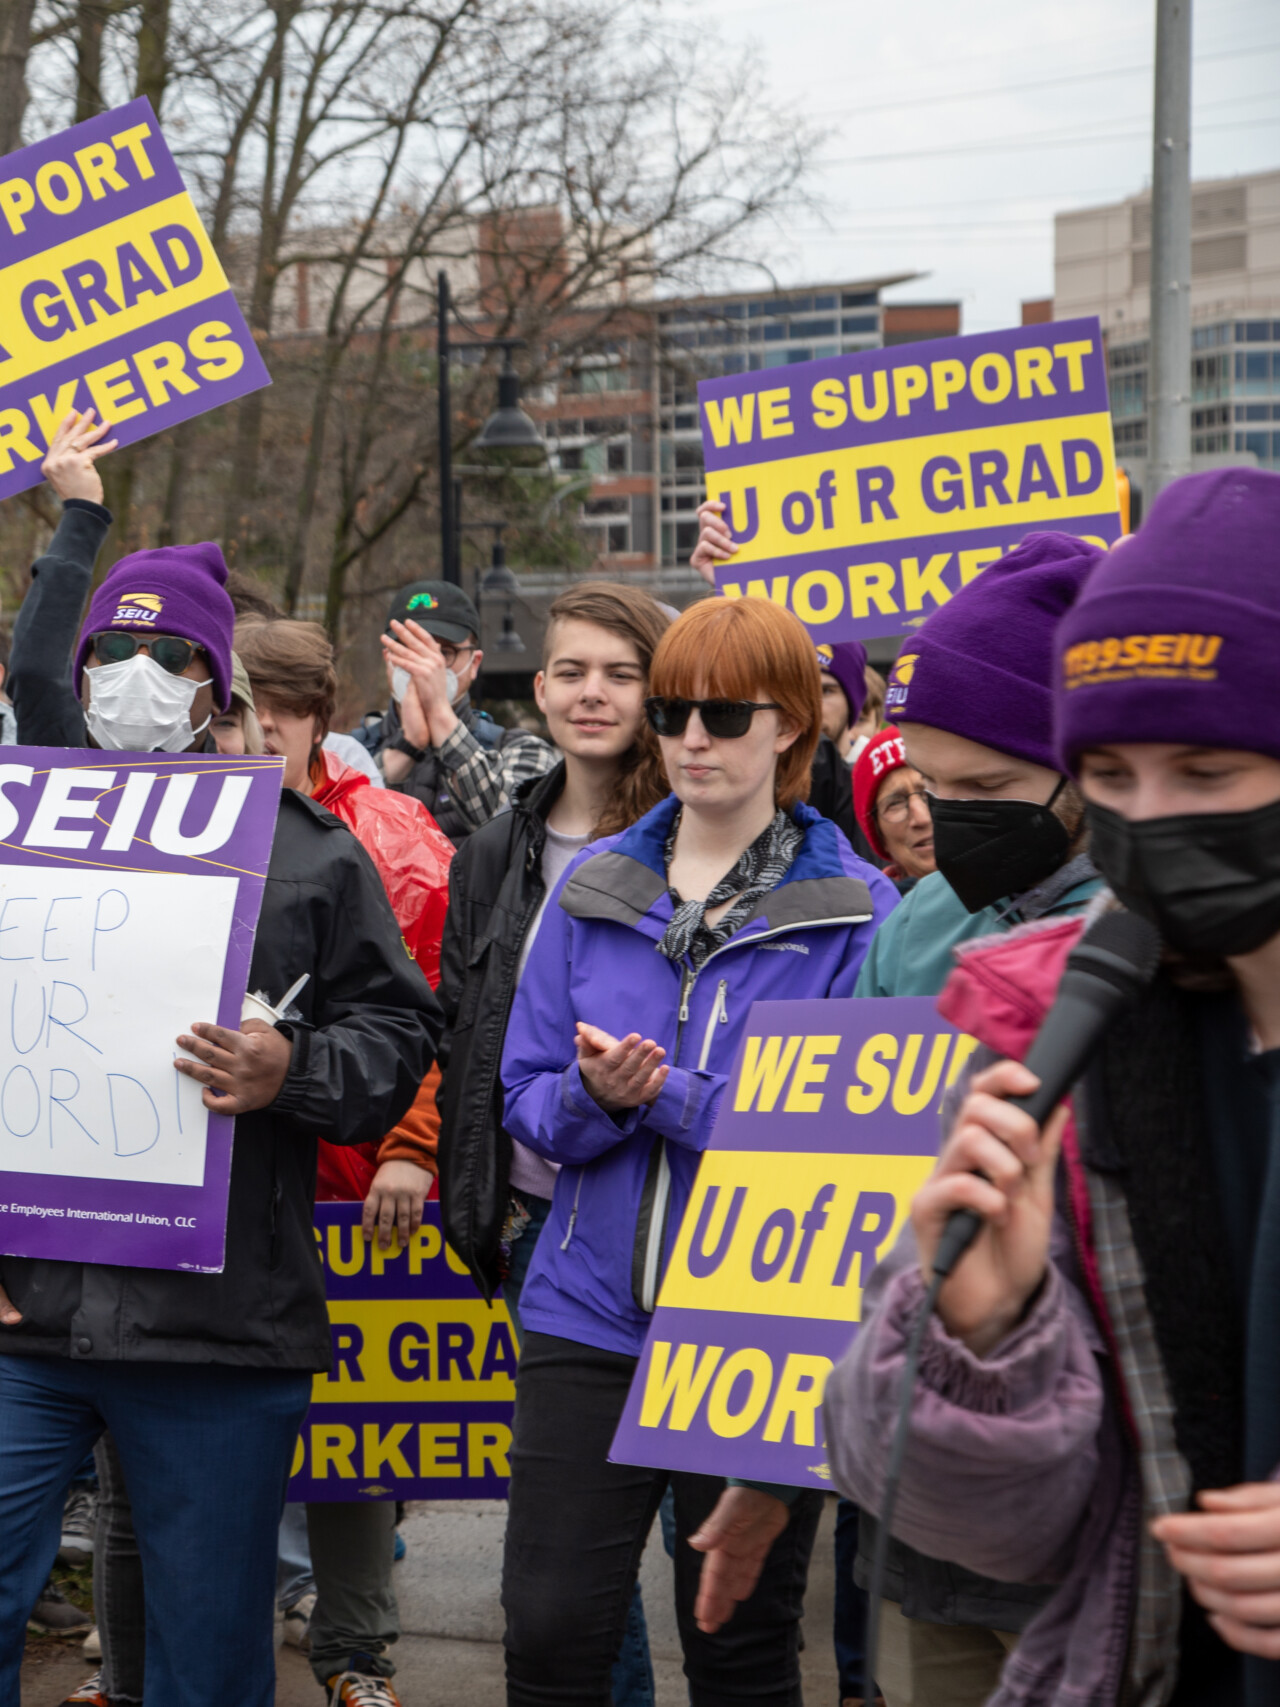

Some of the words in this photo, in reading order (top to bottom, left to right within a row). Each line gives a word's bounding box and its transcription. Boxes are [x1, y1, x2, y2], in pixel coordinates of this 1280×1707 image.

[20, 223, 203, 342] GRAD
[704, 387, 794, 447] WE
[811, 339, 1093, 429] SUPPORT
[720, 487, 759, 544] U
[781, 469, 837, 534] of
[856, 465, 899, 523] R
[921, 438, 1104, 514] GRAD
[113, 608, 158, 620] SEIU
[11, 979, 103, 1054] UR
[733, 1035, 842, 1112] WE
[10, 1203, 64, 1218] Employees
[66, 1208, 133, 1223] International
[135, 1213, 171, 1227] Union,
[174, 1216, 197, 1228] CLC
[688, 1185, 748, 1279] U
[751, 1184, 837, 1283] of
[832, 1191, 896, 1288] R
[327, 1323, 365, 1382] R
